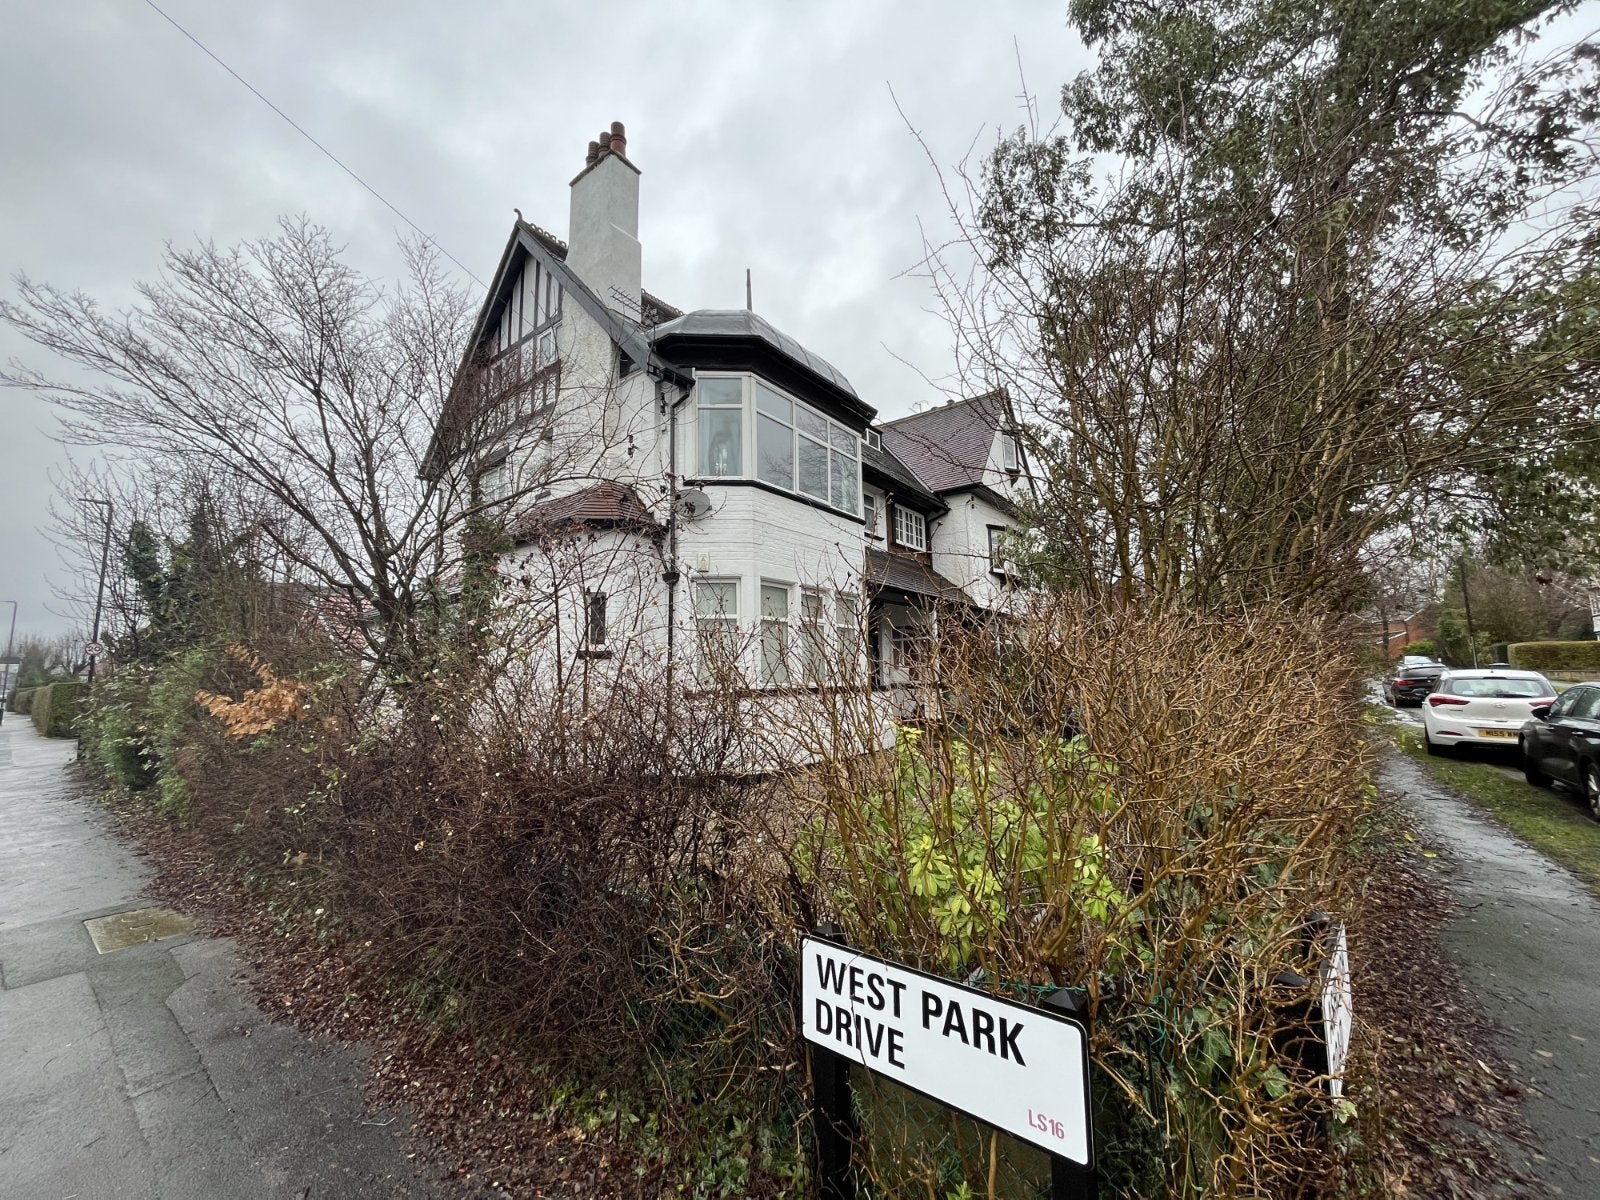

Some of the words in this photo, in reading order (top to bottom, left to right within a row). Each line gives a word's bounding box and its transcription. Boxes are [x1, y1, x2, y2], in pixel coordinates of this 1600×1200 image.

[816, 953, 907, 1019] WEST
[922, 990, 1027, 1067] PARK
[816, 998, 905, 1070] DRIVE
[1028, 1109, 1065, 1140] LS16
